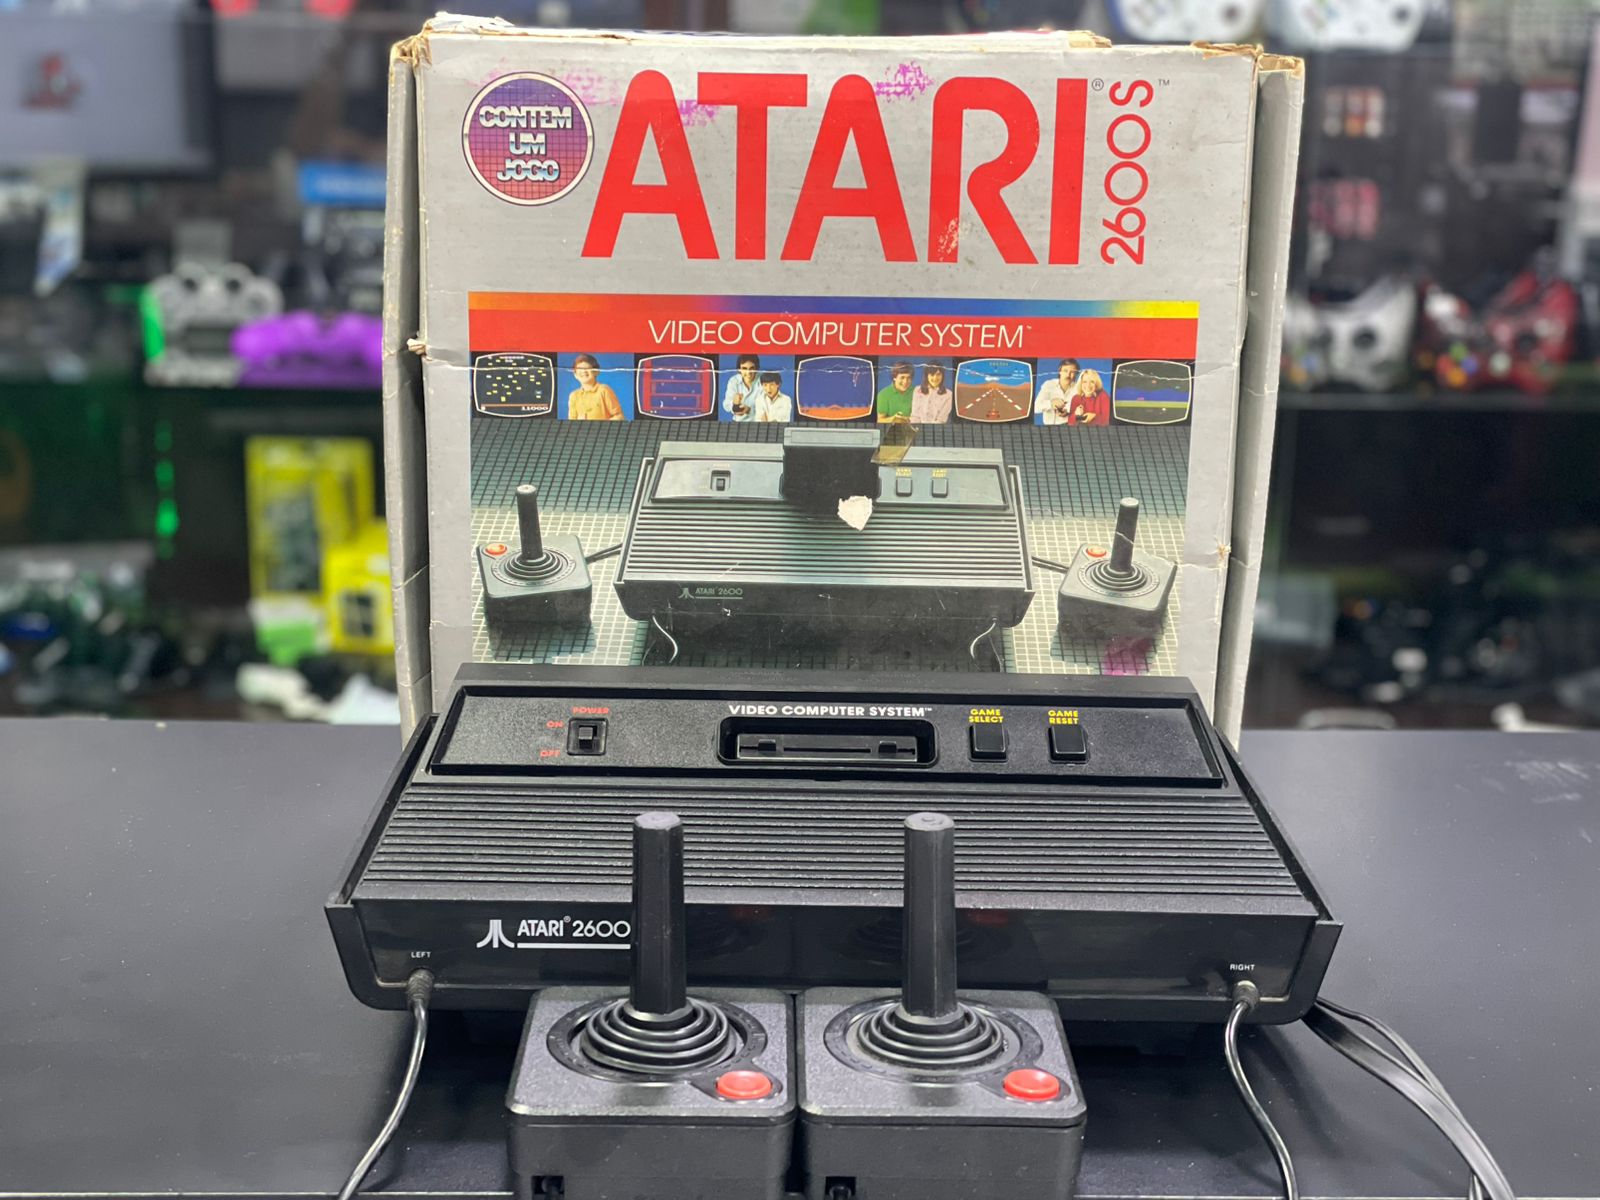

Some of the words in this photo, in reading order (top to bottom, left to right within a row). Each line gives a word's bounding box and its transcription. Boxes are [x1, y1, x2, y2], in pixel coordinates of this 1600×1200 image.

[508, 132, 547, 156] UM
[496, 158, 560, 182] JOGO
[1100, 79, 1154, 265] 2600S
[648, 320, 743, 345] VIDEO
[751, 321, 912, 347] COMPUTER
[718, 587, 743, 595] 2600
[572, 706, 609, 714] POWER
[729, 705, 778, 715] VIDEO
[781, 705, 865, 716] COMPUTER
[970, 708, 1001, 716] GAME
[1047, 710, 1079, 718] GAME
[968, 715, 1004, 723] SELECT
[1048, 717, 1079, 725] RESET
[546, 720, 564, 729] ON
[540, 749, 560, 758] OFF
[572, 920, 632, 938] 2600
[1229, 963, 1255, 971] RIGHT
